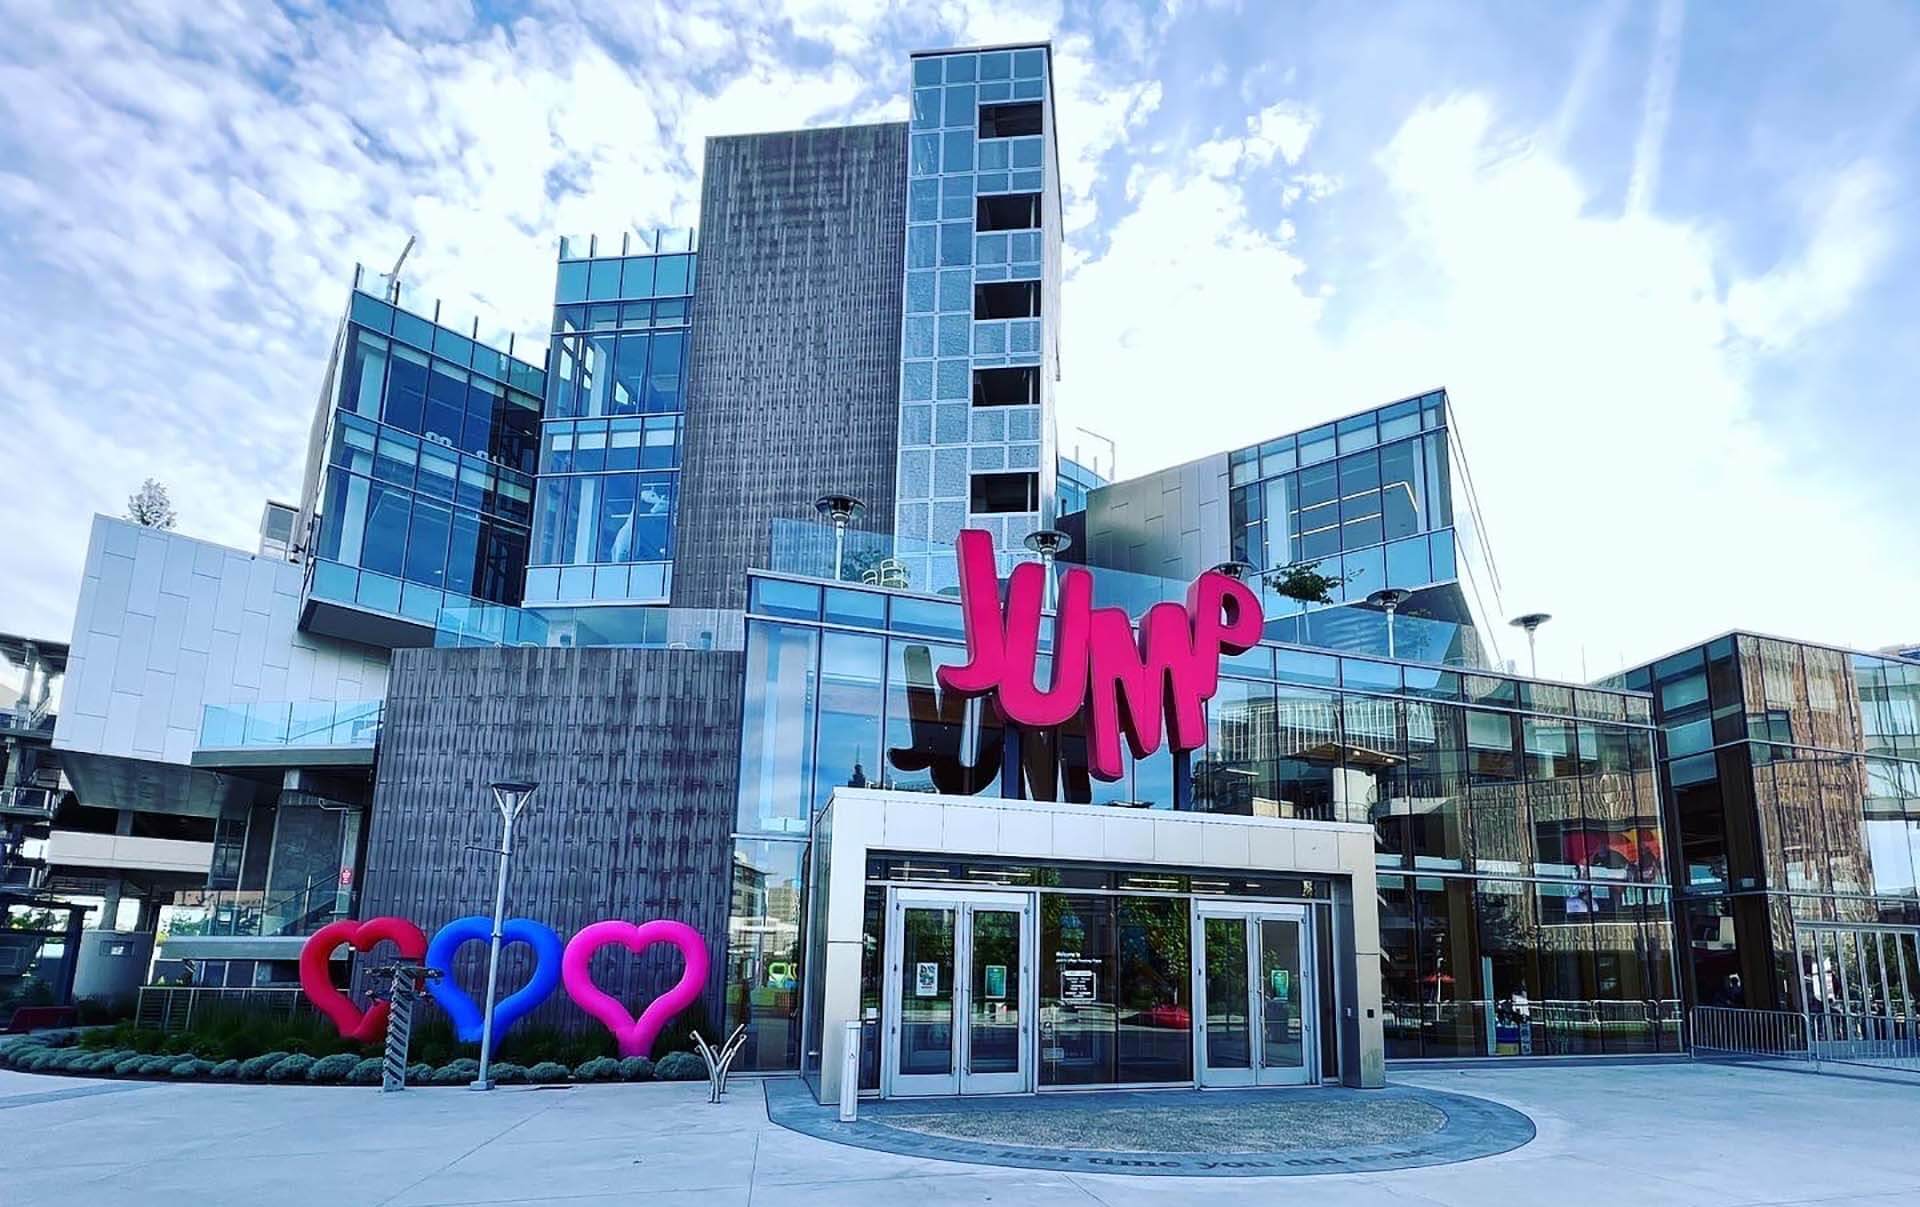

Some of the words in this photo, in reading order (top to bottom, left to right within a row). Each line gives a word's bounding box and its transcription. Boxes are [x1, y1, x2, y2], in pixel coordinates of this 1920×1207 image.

[936, 527, 1265, 783] JUMP
[1089, 1156, 1184, 1169] time
[1195, 1160, 1276, 1171] you
